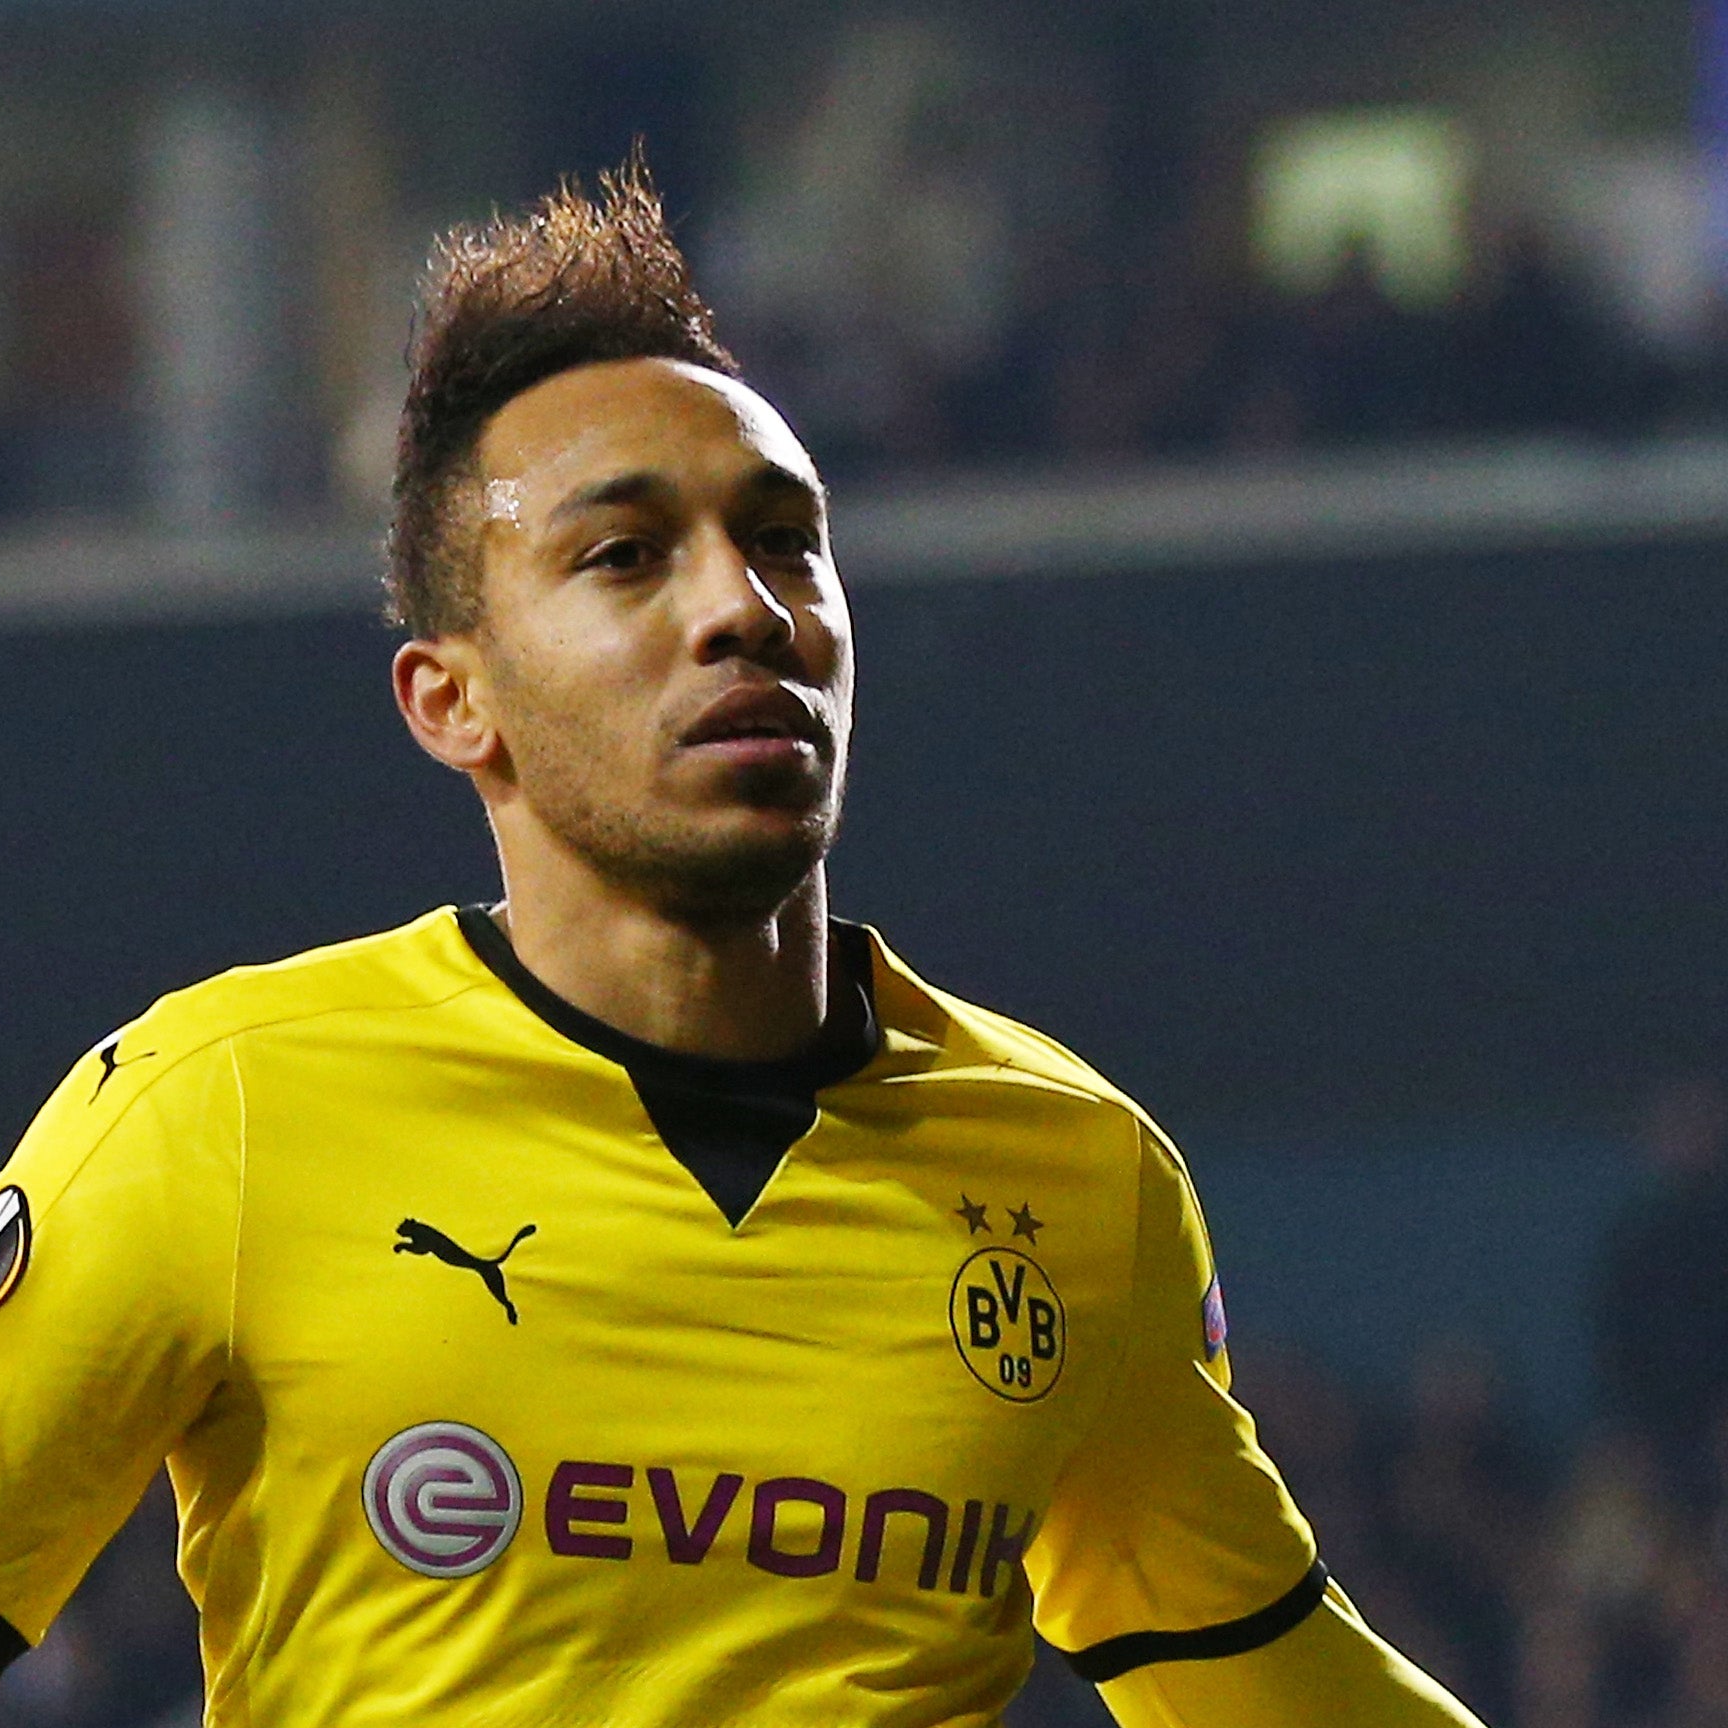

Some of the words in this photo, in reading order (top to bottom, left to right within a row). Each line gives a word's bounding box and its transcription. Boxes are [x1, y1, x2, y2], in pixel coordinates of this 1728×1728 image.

[966, 1259, 1057, 1361] BVB
[998, 1353, 1032, 1388] 09
[544, 1459, 1036, 1598] EVONIK
